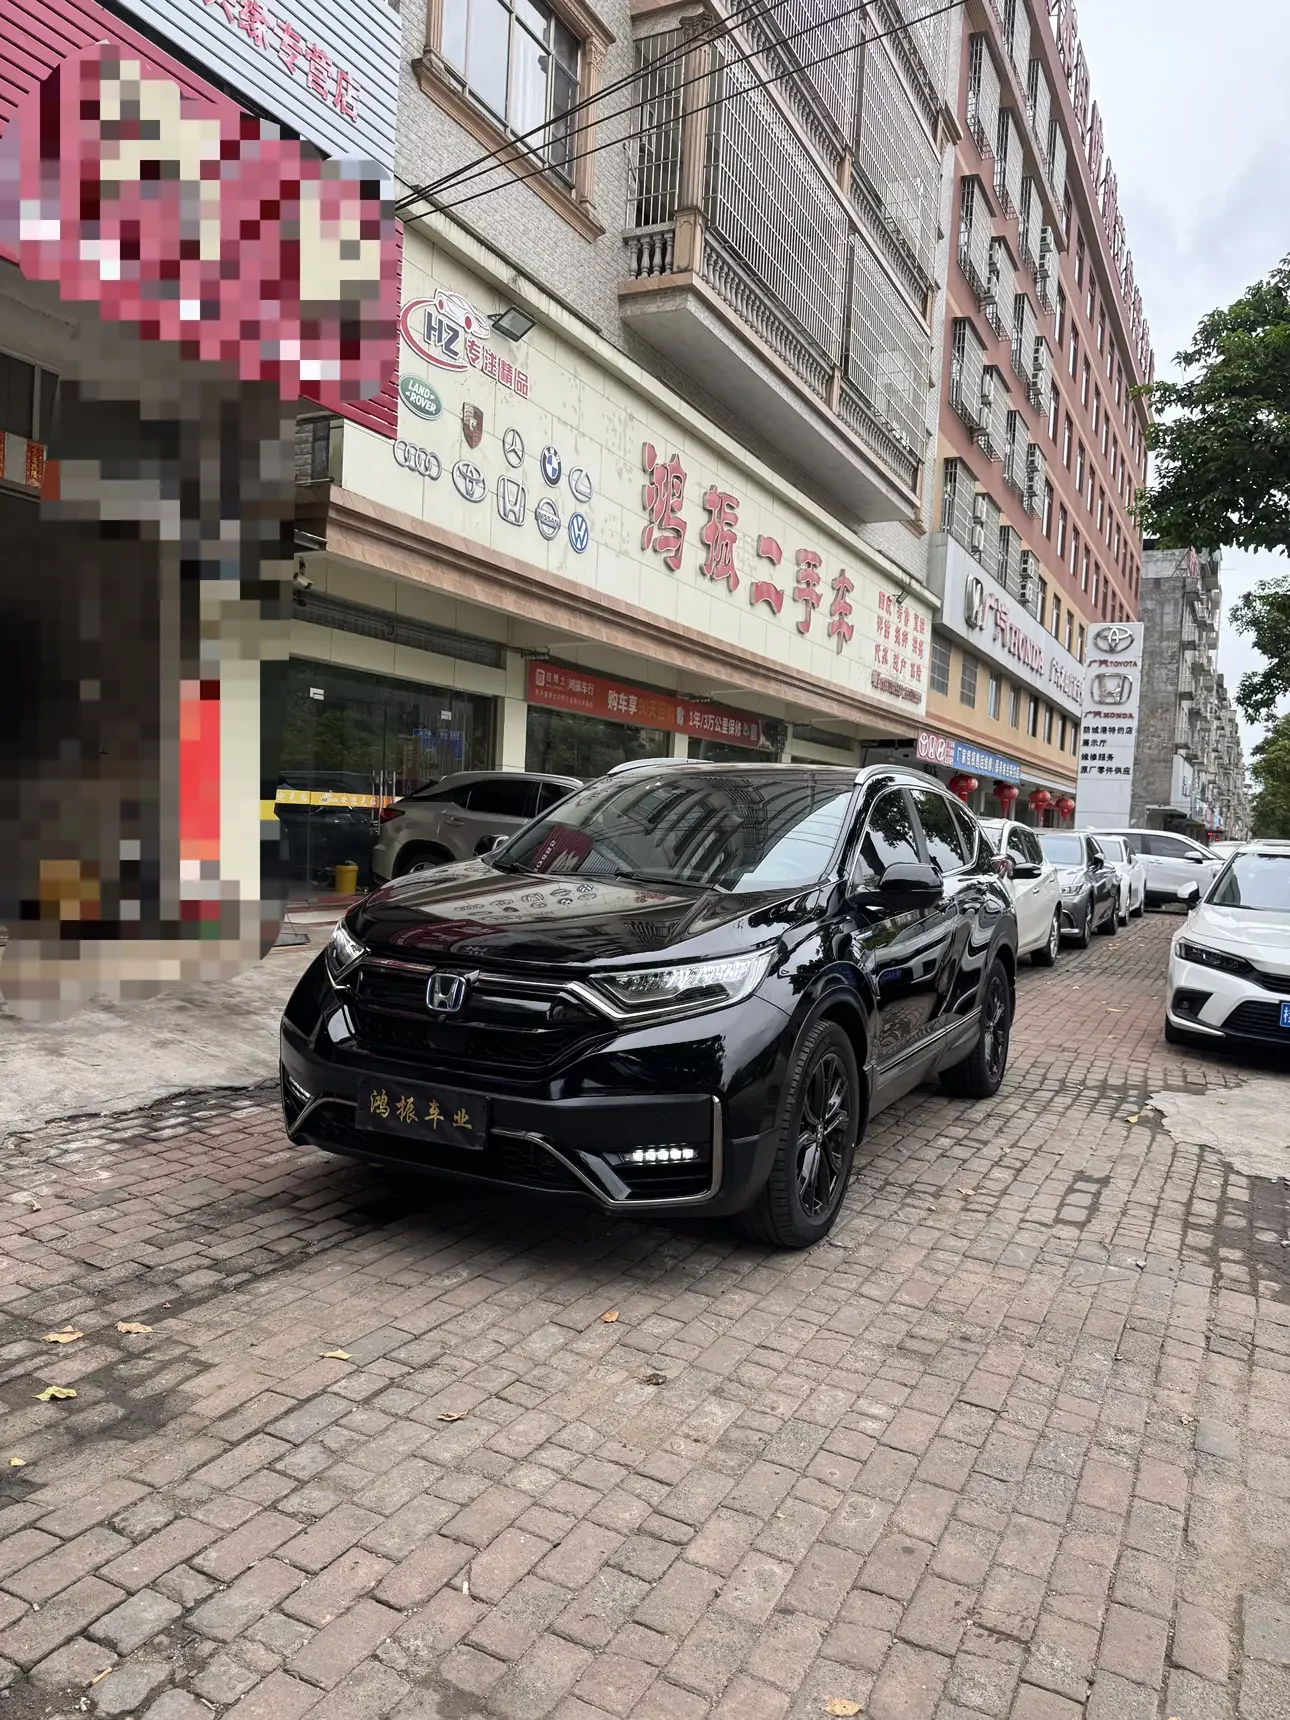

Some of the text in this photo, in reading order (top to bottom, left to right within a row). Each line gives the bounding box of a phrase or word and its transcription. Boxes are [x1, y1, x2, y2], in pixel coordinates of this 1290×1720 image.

[424, 310, 462, 360] HZ
[465, 338, 530, 399] 专注精品
[408, 380, 430, 398] LAND
[410, 392, 436, 413] ROVER
[537, 510, 560, 527] NISSAN
[641, 441, 855, 656] 鸿振二手车
[568, 678, 595, 696] 鸿振车行
[689, 710, 742, 737] 1年/3万公里保修
[1083, 726, 1133, 735] 防城港特约店
[1081, 739, 1107, 747] 展示厅
[1081, 753, 1114, 762] 维修服务
[1080, 766, 1131, 775] 原厂零件供应
[370, 1089, 473, 1130] 鸿振车业
